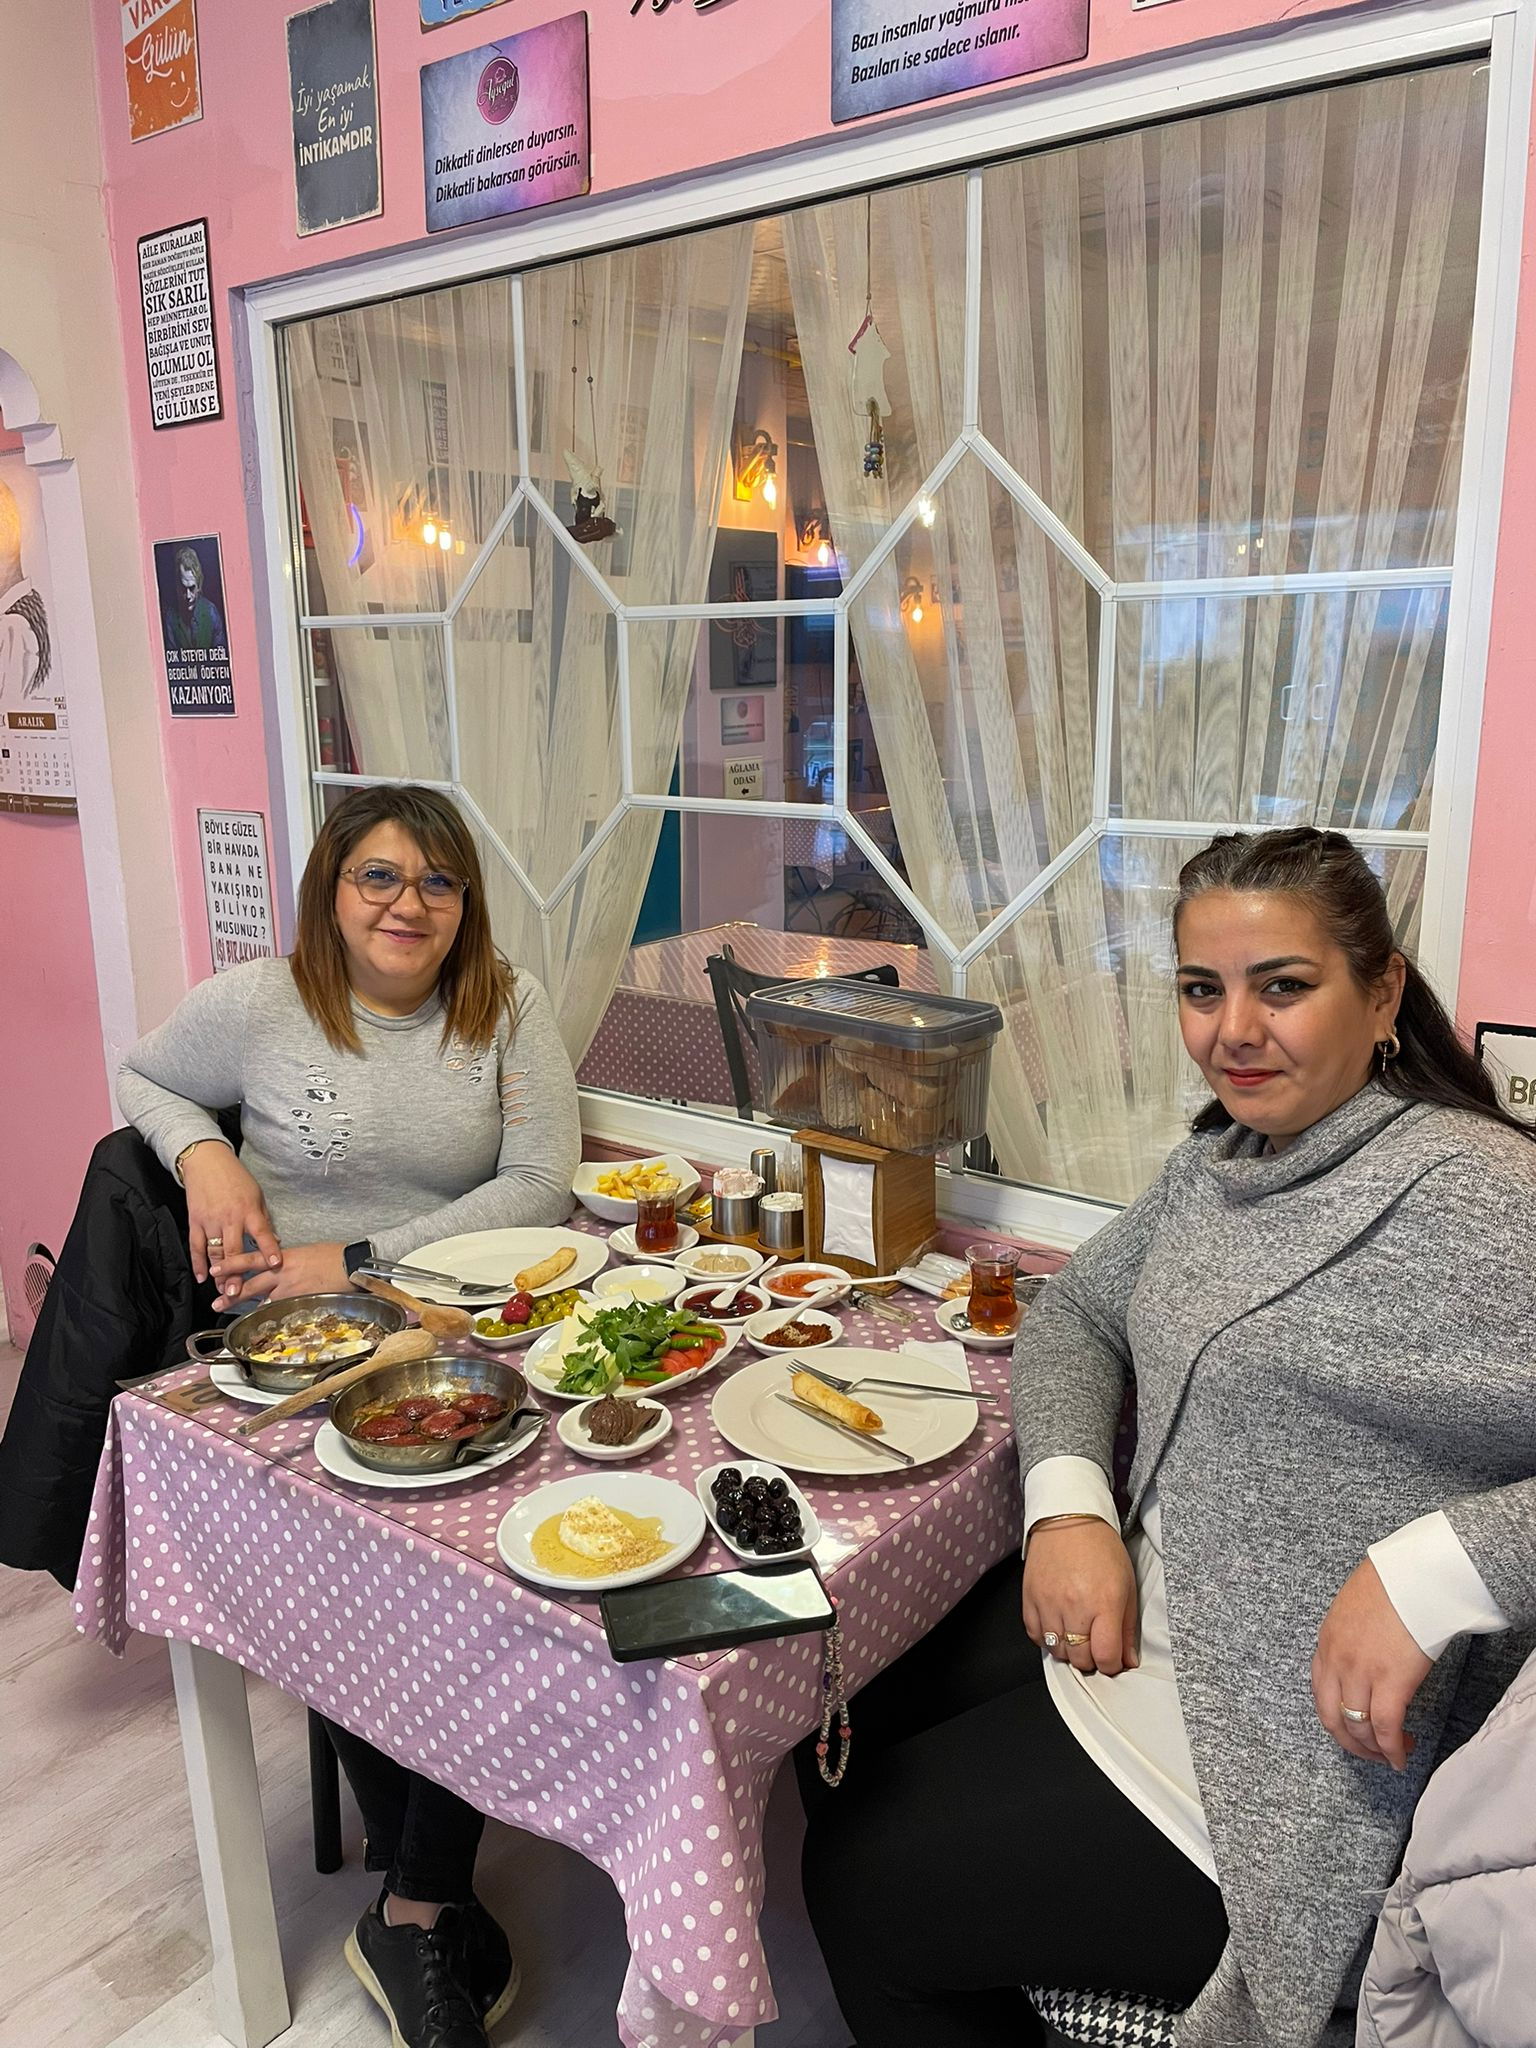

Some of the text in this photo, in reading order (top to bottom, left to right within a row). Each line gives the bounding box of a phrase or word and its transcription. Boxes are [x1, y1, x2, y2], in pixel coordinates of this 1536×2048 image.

[851, 32, 879, 52] Bazı
[881, 15, 936, 44] insanlar
[127, 25, 194, 83] Gülün
[851, 23, 1020, 84] Bazıları ise sadece ıslanır.
[296, 64, 372, 116] İyi yaşamak,
[318, 103, 354, 132] En iyi
[299, 125, 372, 167] İNTİKAMDIR
[434, 123, 578, 175] Dikkatli dinlersen duyarsın.
[436, 151, 580, 203] Dikkatli bakarsan görürsün.
[142, 230, 203, 259] AİLE KURALLARI
[145, 267, 205, 295] SÖZLERİNİ TUT
[146, 283, 207, 315] SIK SARIL
[148, 316, 160, 327] HEP
[198, 304, 208, 314] OL
[148, 318, 209, 344] BİRBİRİNİ SEV
[149, 334, 211, 358] BAĞIŞLA VE UNUT
[151, 350, 213, 377] OLUMLU OL
[154, 380, 215, 401] YENİ ŞEYLER DENE
[156, 395, 216, 421] GÜLÜMSE
[180, 648, 207, 662] İSTEYEN
[200, 665, 230, 679] ÖDEYEN
[171, 685, 233, 705] KAZANIYOR!
[17, 716, 45, 727] ARALIK
[729, 763, 760, 774] AĞLAMA
[733, 775, 756, 785] ODASI
[204, 819, 258, 838] BÖYLE GÜZEL
[207, 839, 259, 858] BİR HAVADA
[210, 861, 262, 879] BANA NE
[211, 881, 263, 899] YAKIŞIRDI
[214, 899, 265, 919] BİLİYOR
[215, 920, 258, 938] MUSUNUZ
